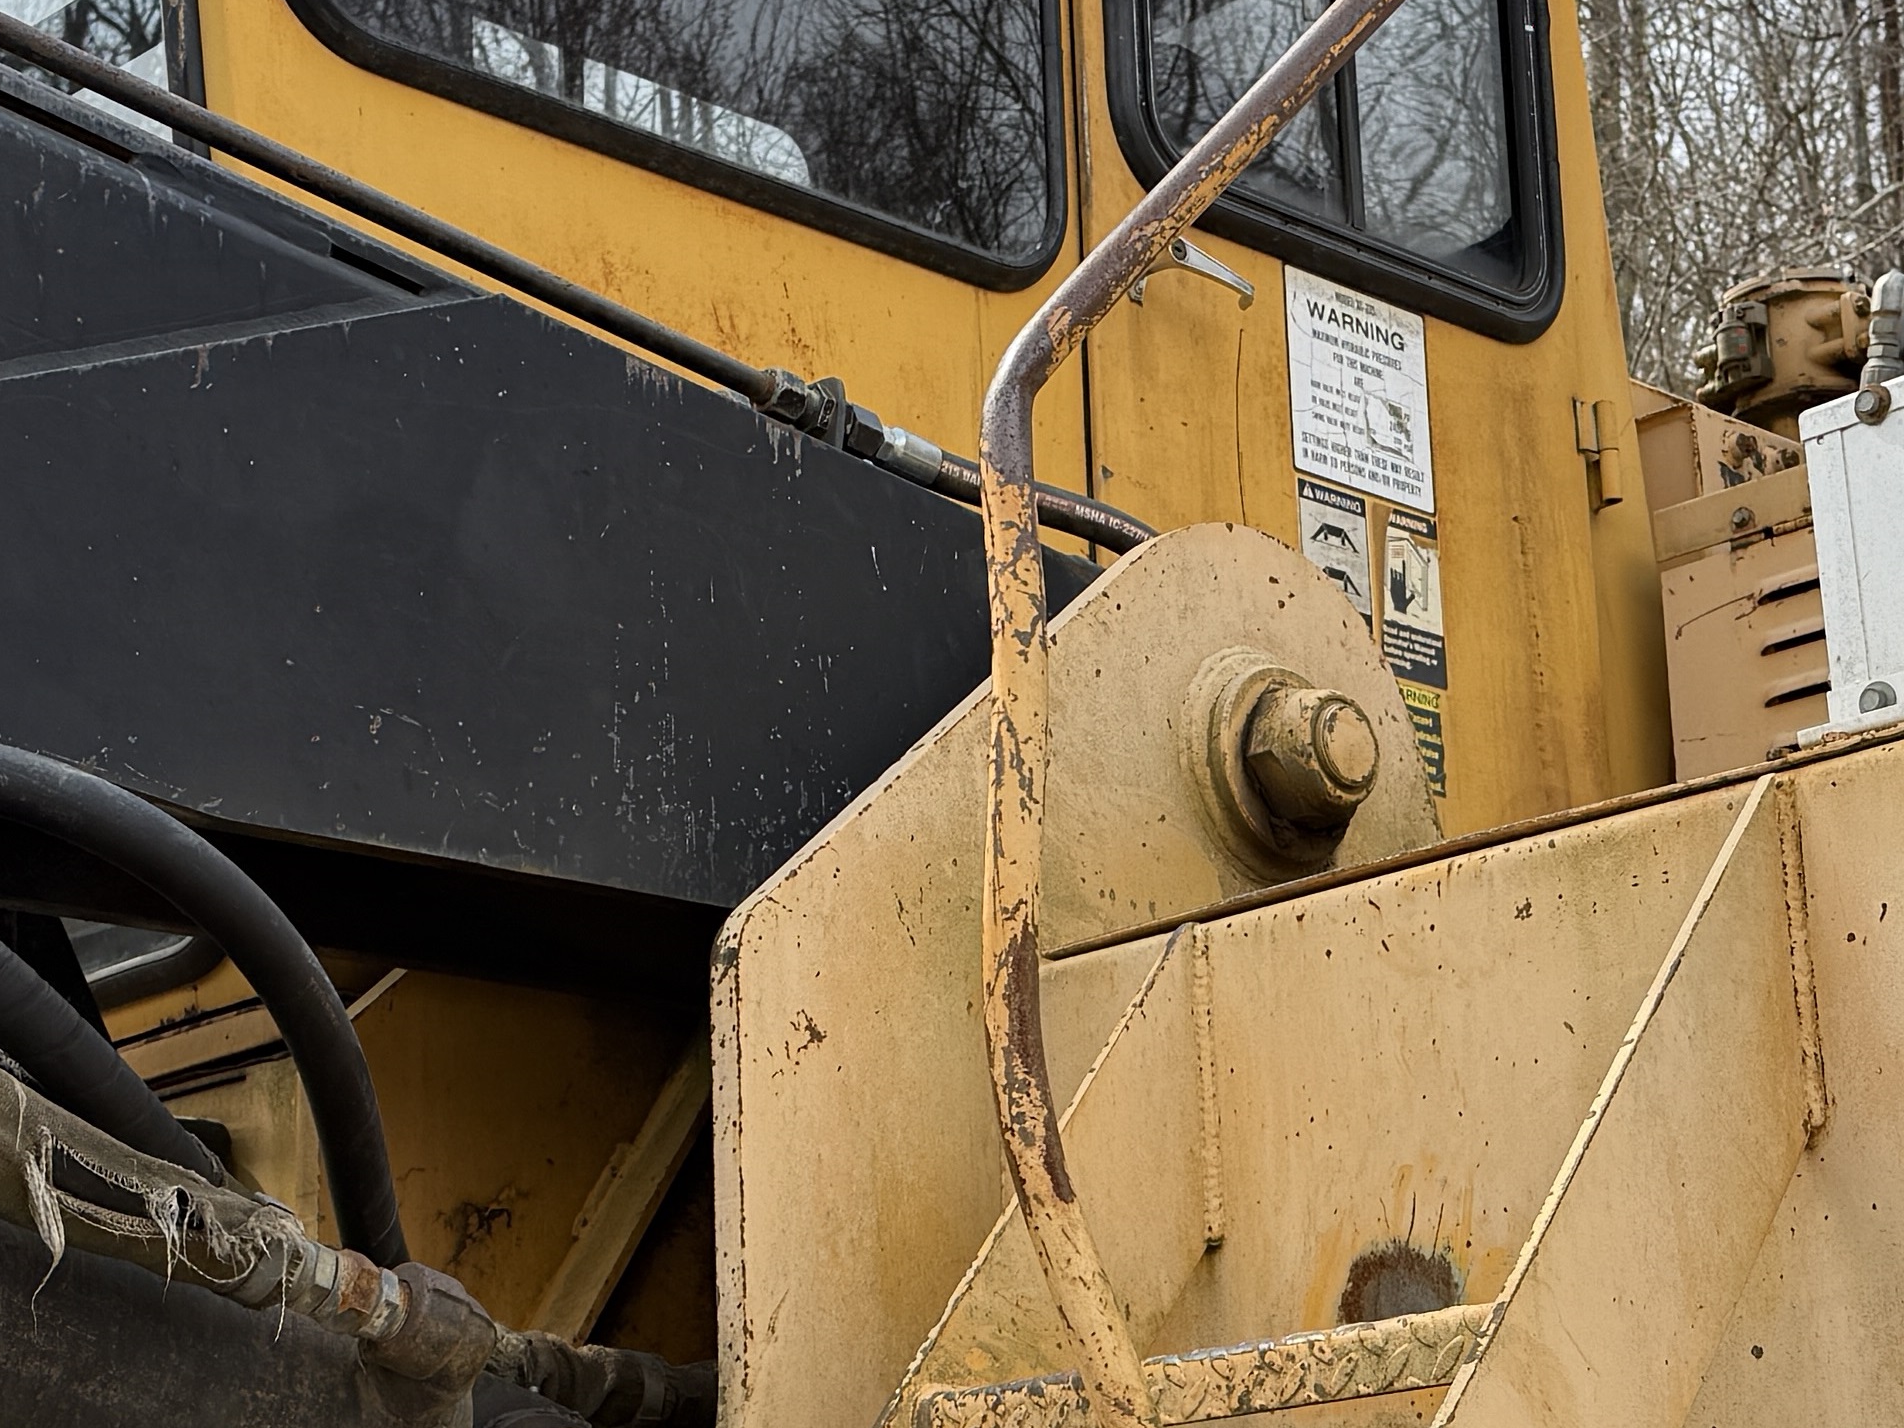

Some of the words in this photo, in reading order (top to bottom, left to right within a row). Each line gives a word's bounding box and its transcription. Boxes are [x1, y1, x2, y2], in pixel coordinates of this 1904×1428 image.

[1306, 298, 1405, 352] WARNING
[1074, 503, 1106, 525] MSHA
[1314, 488, 1362, 514] WARNING
